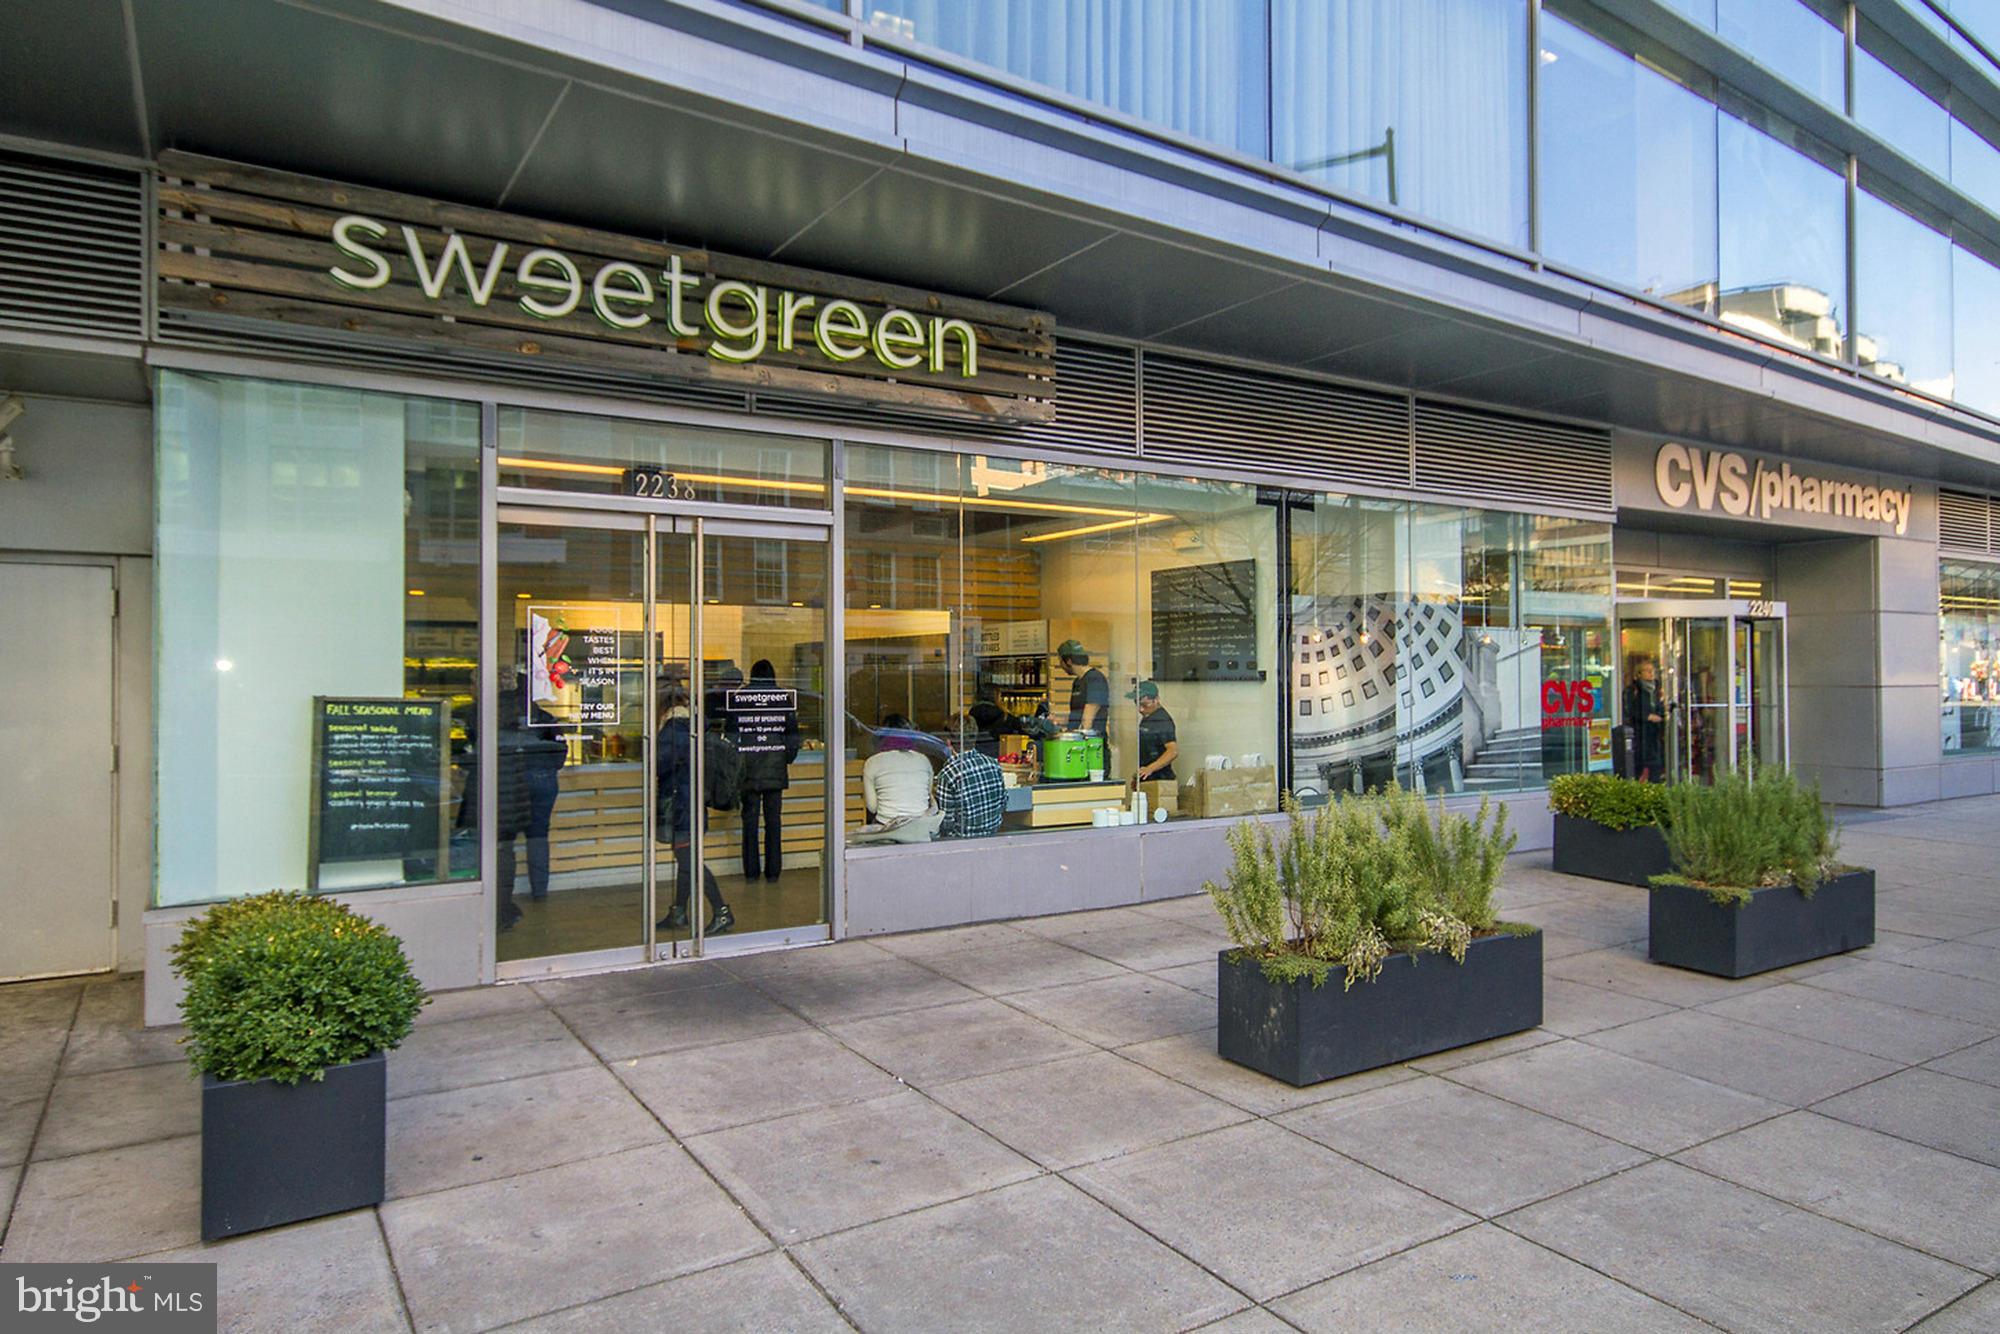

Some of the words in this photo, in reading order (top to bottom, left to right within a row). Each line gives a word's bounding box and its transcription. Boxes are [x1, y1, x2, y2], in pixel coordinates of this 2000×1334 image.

[329, 214, 979, 378] sweetgreen
[635, 473, 696, 501] 2238
[1655, 442, 1912, 535] CVS/pharmacy
[1747, 600, 1774, 618] 2240
[583, 636, 615, 645] TASTES
[592, 646, 615, 655] BEST
[587, 656, 615, 665] WHEN
[579, 677, 615, 686] SEASON
[735, 693, 788, 703] sweetgreen
[1541, 679, 1594, 715] CVS
[326, 704, 350, 716] FALL
[352, 705, 400, 716] SEASONAL
[580, 703, 595, 711] TRY
[596, 703, 615, 711] OUR
[590, 712, 615, 721] MENU
[1541, 716, 1593, 732] pharmacy
